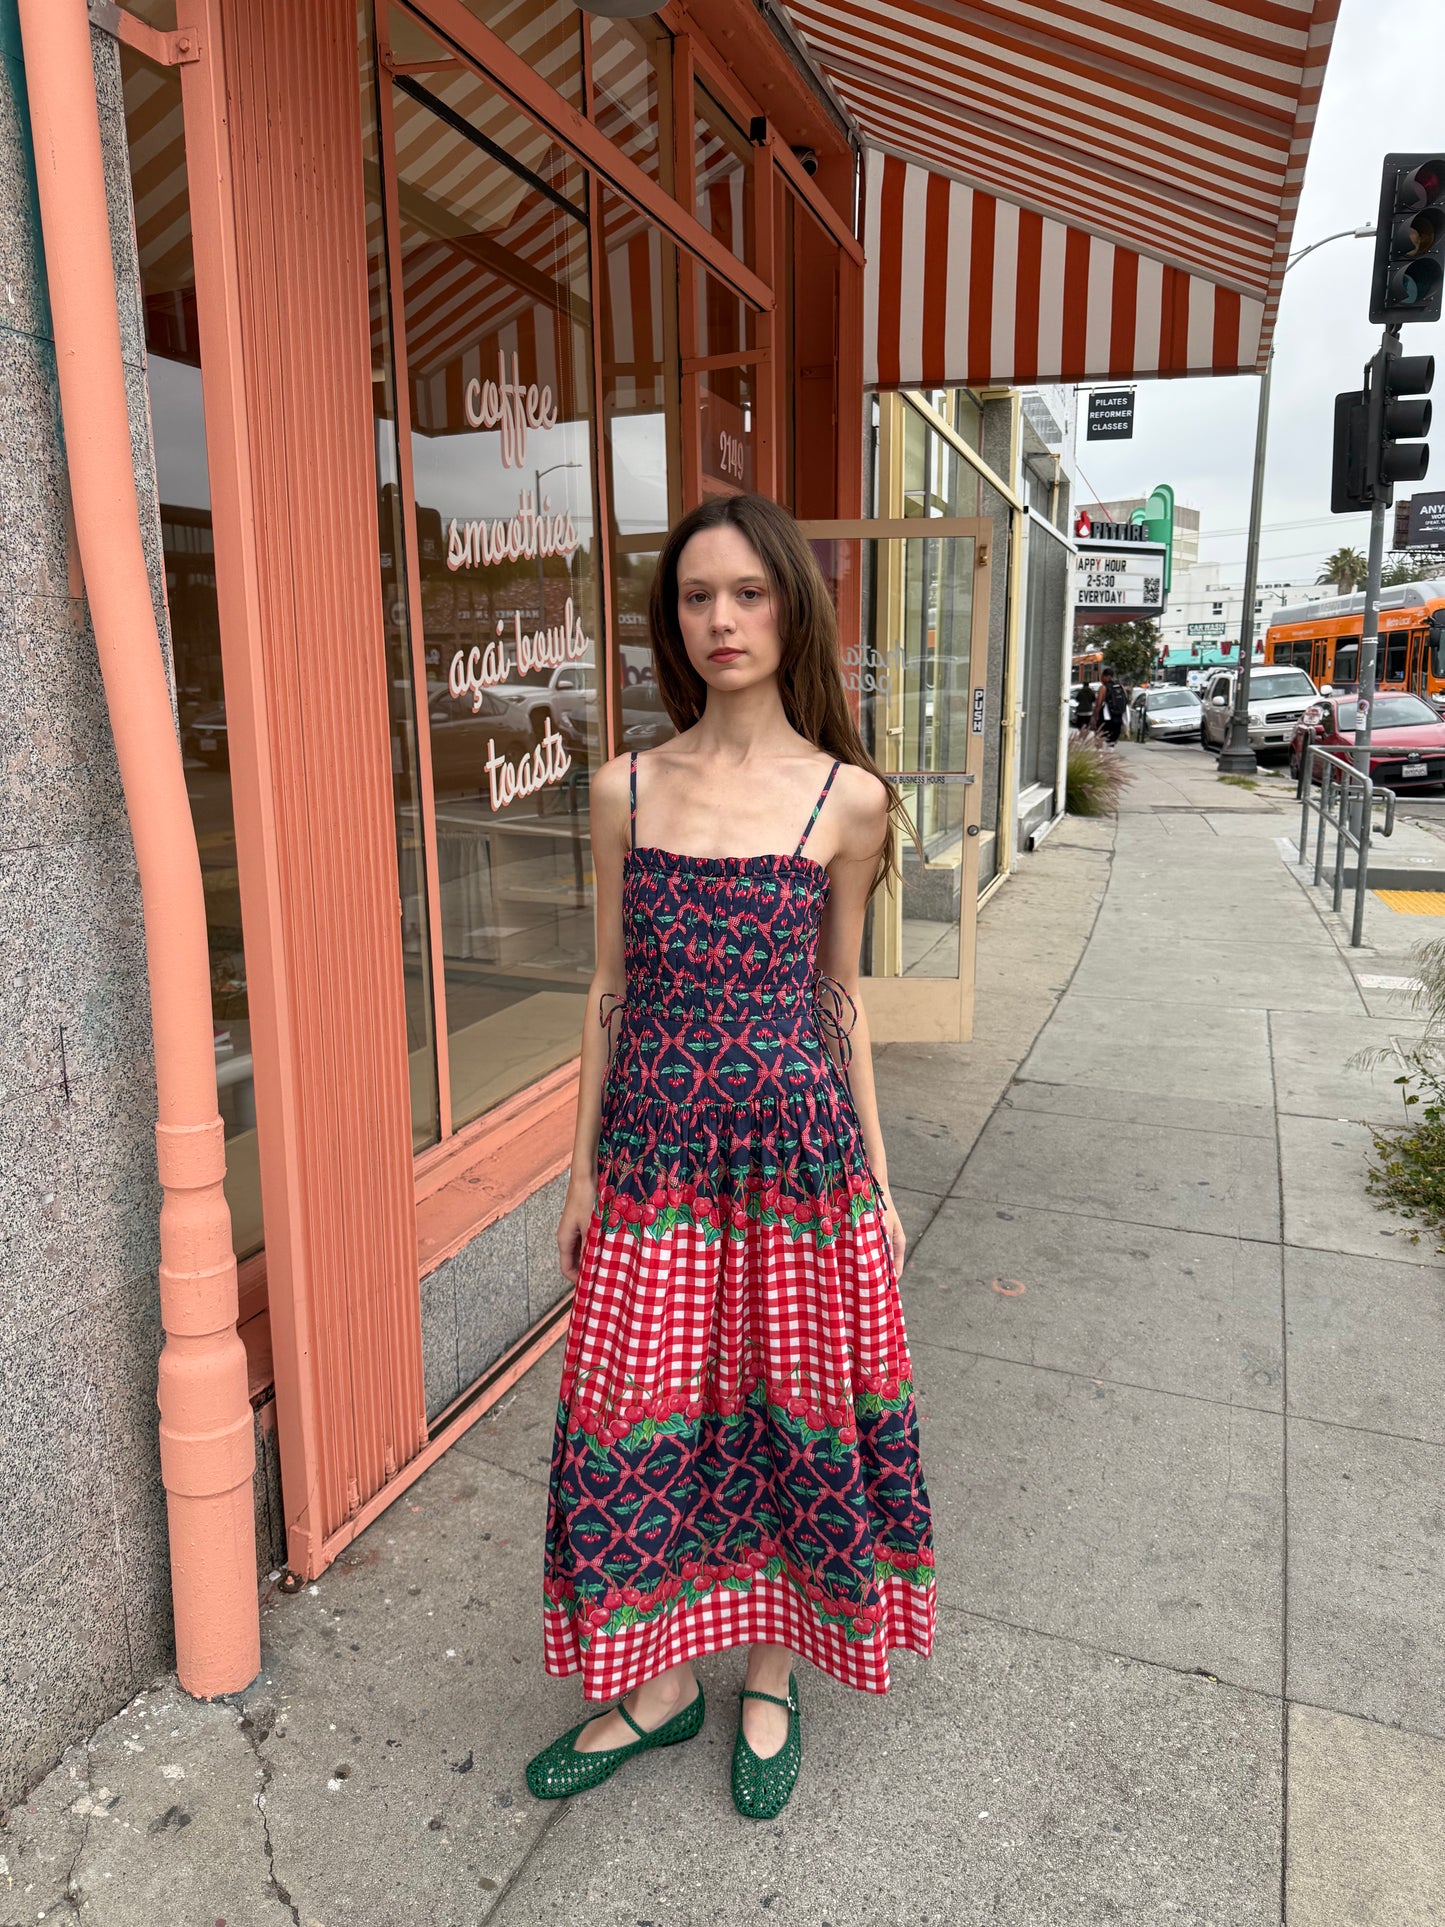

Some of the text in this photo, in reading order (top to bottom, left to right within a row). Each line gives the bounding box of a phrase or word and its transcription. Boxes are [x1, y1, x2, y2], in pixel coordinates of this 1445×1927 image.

[465, 349, 557, 469] coffee
[1095, 398, 1128, 406] PILATES
[1089, 410, 1133, 419] REFORMER
[1092, 422, 1129, 431] CLASSES
[720, 430, 744, 480] 2149
[1420, 504, 1445, 515] ANY
[447, 488, 578, 571] smoothies
[1076, 558, 1127, 573] APPY HOUR
[1087, 575, 1115, 587] 2-5:30
[1078, 590, 1126, 604] EVERYDAY!
[514, 597, 590, 677] bowls
[974, 689, 984, 731] PUSH
[484, 716, 572, 812] toasts
[899, 775, 925, 784] BUSINESS
[926, 775, 945, 784] HOURS
